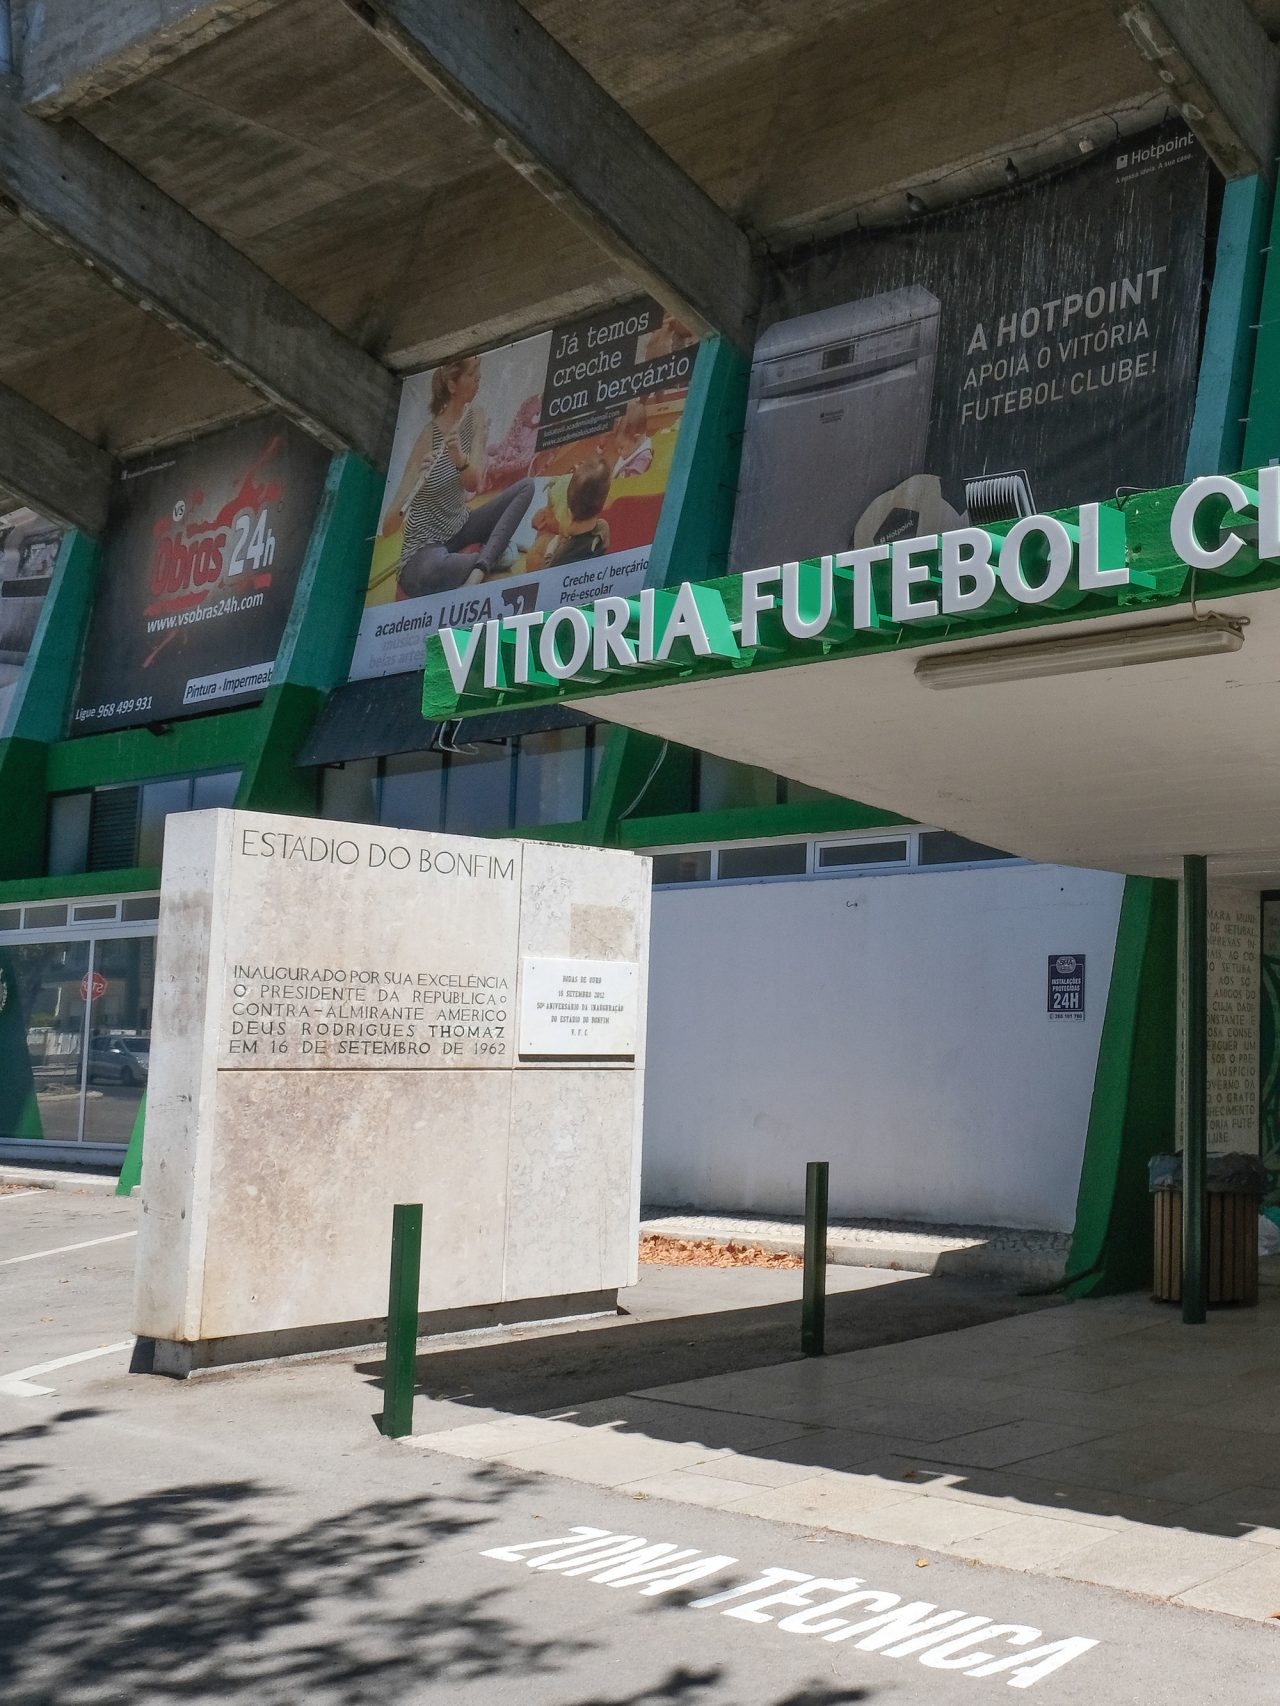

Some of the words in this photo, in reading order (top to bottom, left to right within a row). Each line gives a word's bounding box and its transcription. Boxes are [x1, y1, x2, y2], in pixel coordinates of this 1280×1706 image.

[1131, 131, 1194, 165] Hotpoint
[967, 322, 989, 357] A
[996, 266, 1167, 348] HOTPOINT
[555, 331, 580, 360] Já
[587, 311, 650, 349] temos
[962, 353, 1030, 391] APOIA
[1037, 346, 1051, 369] O
[1058, 317, 1150, 363] VITÓRIA
[549, 389, 589, 417] com
[595, 355, 690, 403] berçário
[552, 350, 622, 388] creche
[960, 379, 1063, 426] FUTEBOL
[1070, 350, 1158, 396] CLUBE!
[150, 532, 227, 597] Obras
[228, 508, 276, 577] 24h
[562, 572, 596, 589] Creche
[597, 567, 608, 582] c/
[609, 558, 650, 579] berçário
[741, 501, 1131, 648] FUTEBOL
[560, 582, 614, 604] Pré-escolar
[147, 591, 264, 634] www.vsobras24h.com
[375, 611, 433, 638] academia
[437, 581, 711, 695] VITORIA
[75, 708, 96, 722] Ligue
[97, 703, 115, 719] 968
[116, 699, 134, 715] 499
[134, 696, 153, 712] 931
[186, 682, 217, 699] Pintura
[241, 829, 360, 865] ESTÁDIO
[368, 843, 412, 870] DO
[419, 848, 515, 881] BONFIM
[233, 964, 347, 983] INAUGURADO
[350, 970, 381, 984] POR
[384, 971, 413, 985] SUA
[233, 984, 247, 998] O
[260, 984, 366, 1002] PRESIDENTE
[378, 989, 399, 1002] DA
[1053, 992, 1079, 1009] 24H
[229, 1040, 258, 1055] EM
[271, 1039, 289, 1054] 16
[302, 1040, 327, 1055] DE
[338, 1040, 431, 1056] SETEMBRO
[442, 1042, 464, 1056] DE
[474, 1042, 507, 1056] 1962
[231, 1021, 287, 1036] DEUS
[301, 1022, 415, 1038] RODRIGUES
[428, 1025, 505, 1039] THOMAZ
[478, 1525, 740, 1598] ZONA
[687, 1566, 1103, 1690] TÉCNICA
